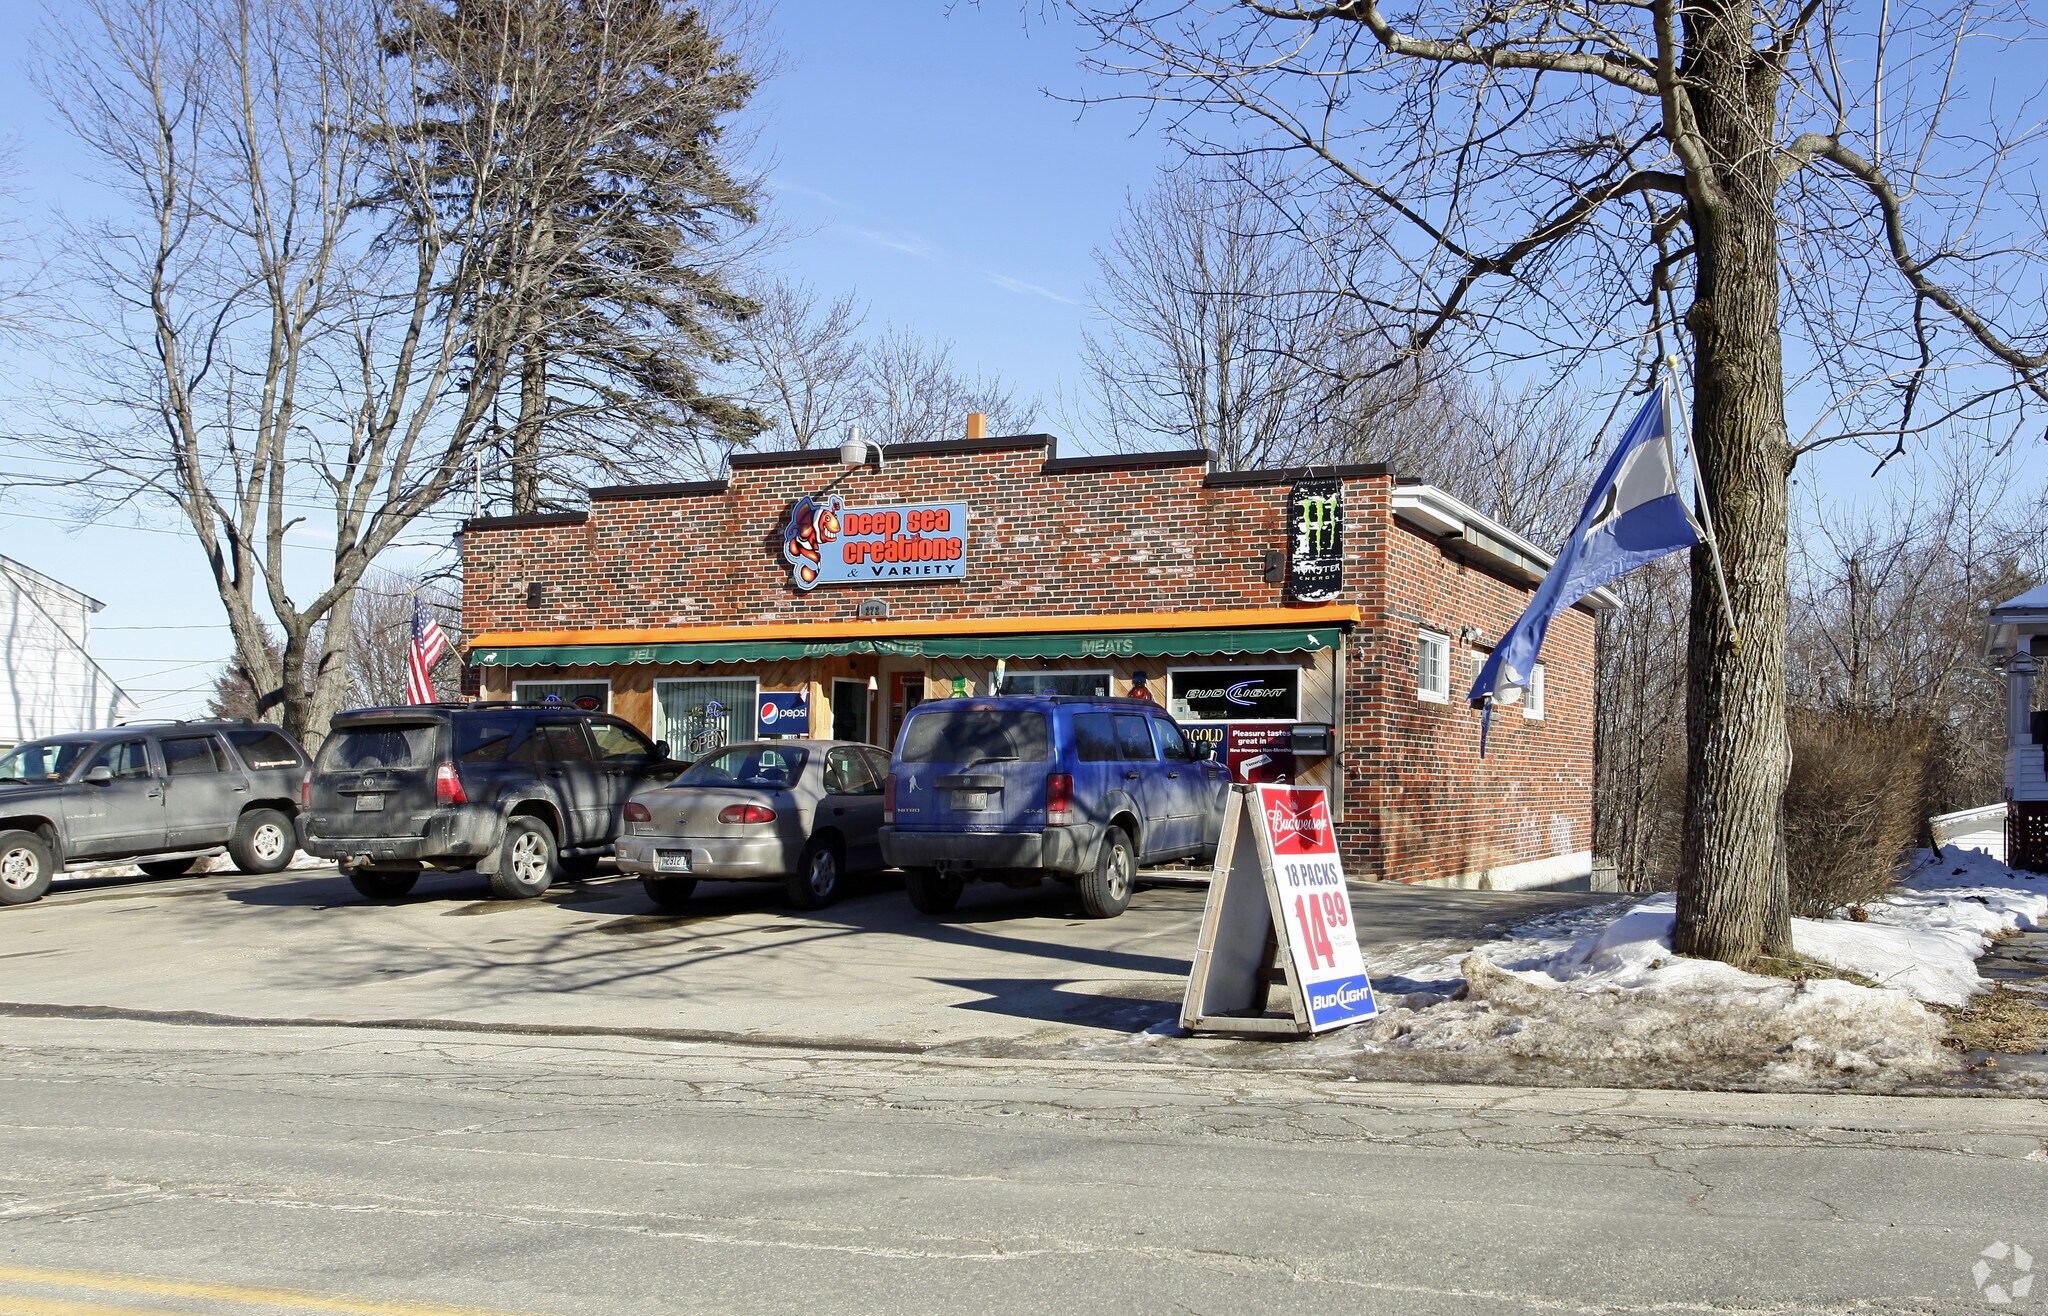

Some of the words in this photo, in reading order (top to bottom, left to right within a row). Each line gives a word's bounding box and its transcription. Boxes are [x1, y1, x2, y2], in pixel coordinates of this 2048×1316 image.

[843, 510, 902, 541] Deep
[906, 508, 950, 532] sea
[842, 533, 962, 565] creations
[847, 568, 858, 577] &
[871, 564, 955, 576] VARIETY
[803, 642, 850, 654] LUNCH
[1081, 639, 1133, 653] MEATS
[1185, 688, 1226, 699] BUD
[1233, 687, 1287, 698] LIGHT
[779, 708, 807, 719] pepsi
[688, 730, 727, 754] OPEN
[1191, 728, 1224, 742] GOLD
[1238, 738, 1258, 746] great
[1267, 810, 1327, 832] Budweiser
[1285, 863, 1300, 887] 18
[1300, 862, 1339, 887] PACKS
[1313, 993, 1338, 1010] BUD
[1340, 986, 1369, 1004] LIGHT
